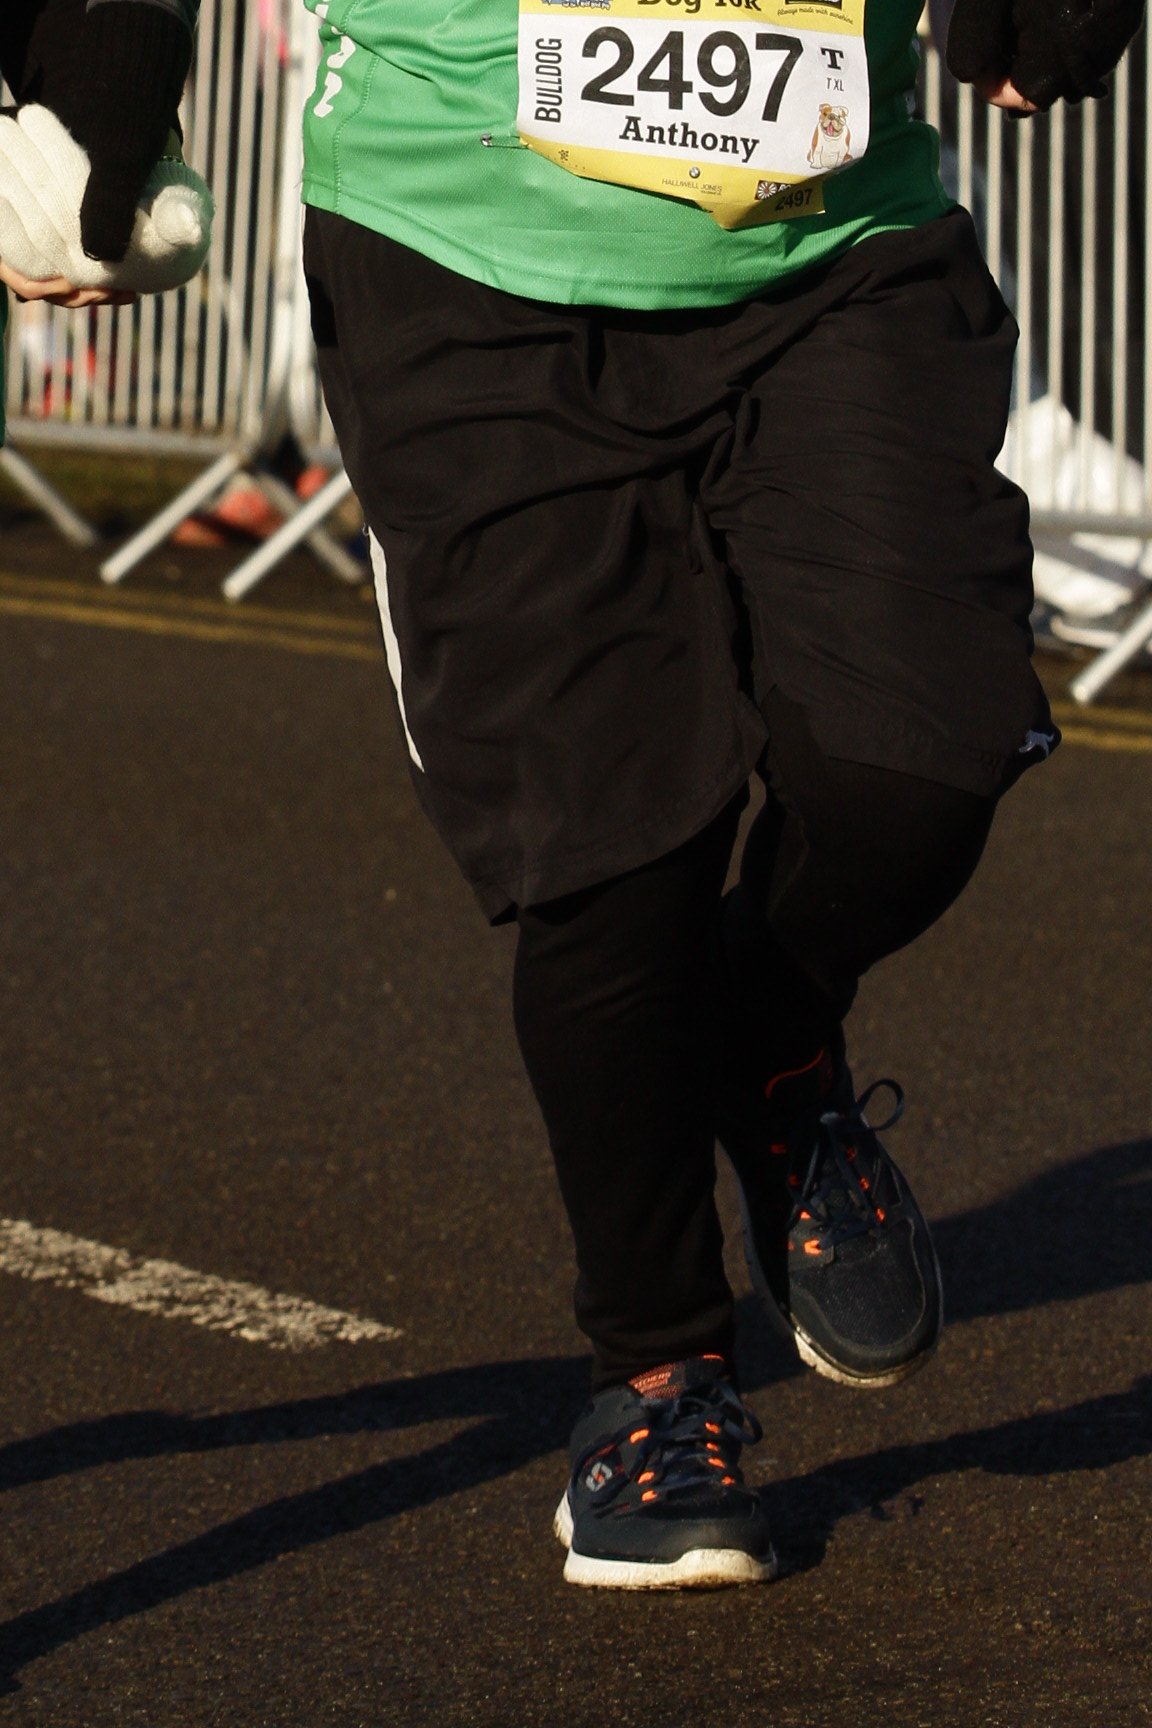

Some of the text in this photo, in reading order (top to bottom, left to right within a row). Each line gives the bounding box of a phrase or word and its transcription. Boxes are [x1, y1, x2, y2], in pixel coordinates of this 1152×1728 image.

[581, 26, 804, 122] 2497
[821, 47, 844, 70] T
[535, 38, 562, 123] BULLDOG
[827, 78, 844, 92] T XL
[619, 116, 759, 163] Anthony
[775, 189, 813, 211] 2497
